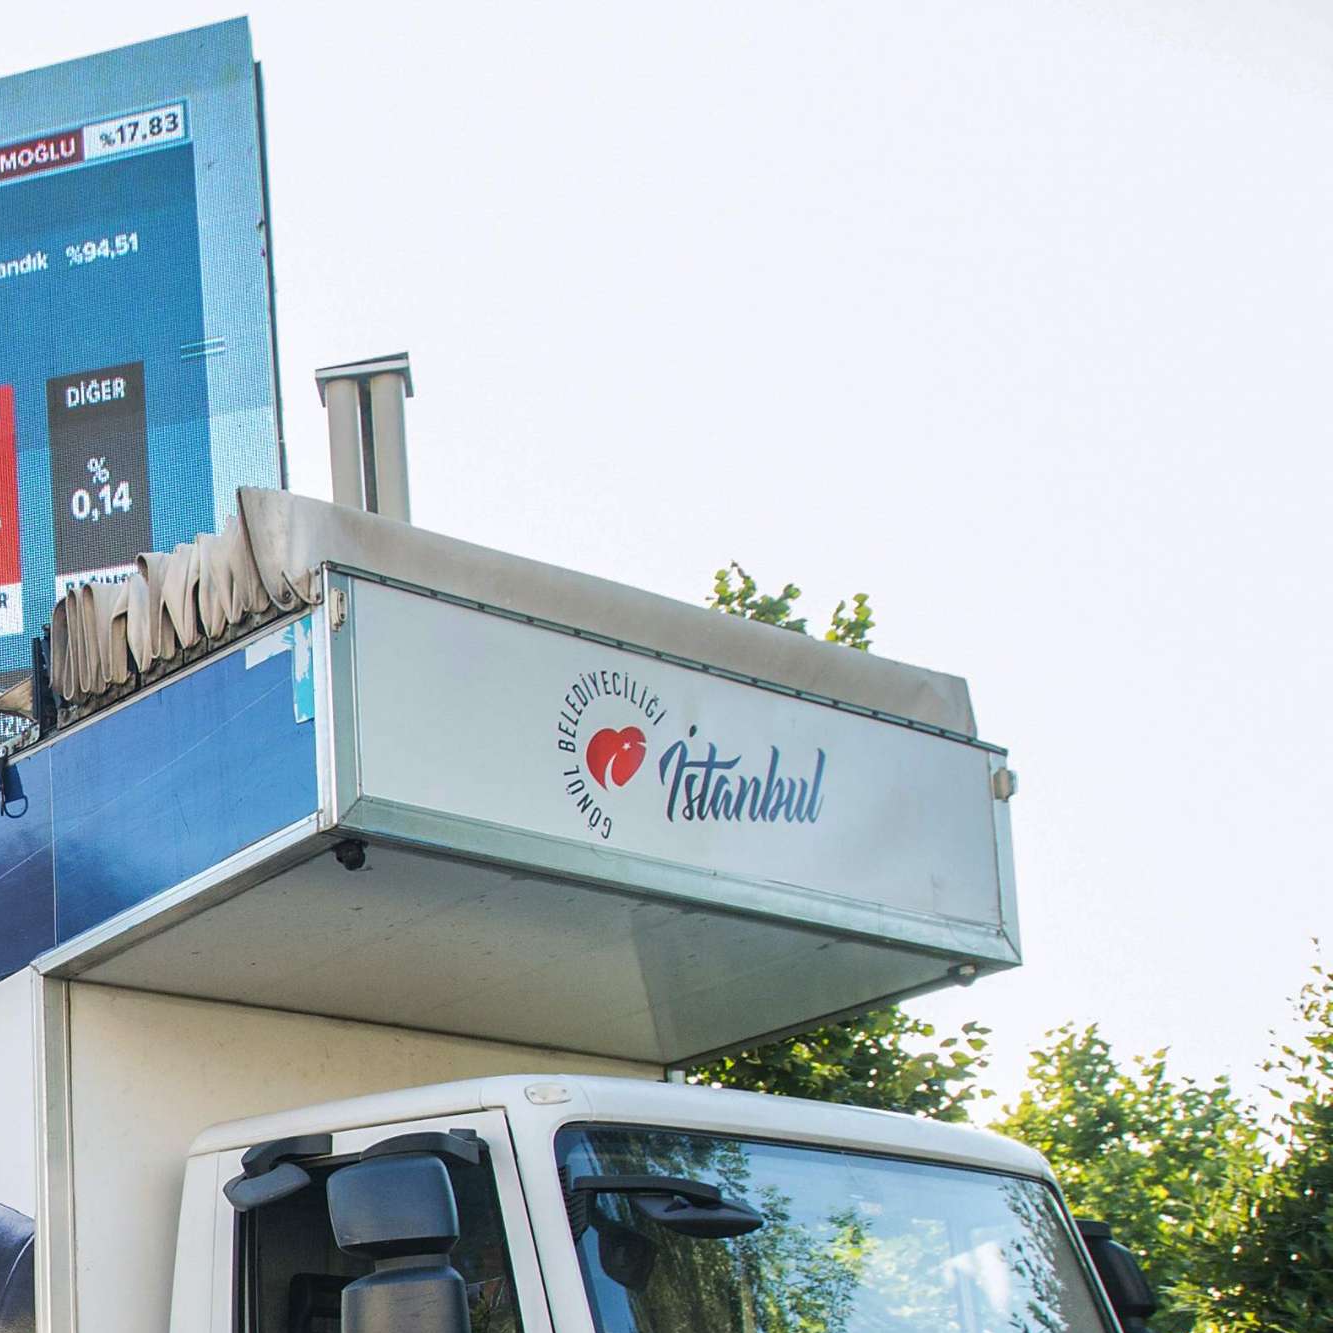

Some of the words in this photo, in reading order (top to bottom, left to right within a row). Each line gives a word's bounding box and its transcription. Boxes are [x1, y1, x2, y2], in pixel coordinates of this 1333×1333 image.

[66, 377, 126, 408] DİĞER
[71, 481, 133, 522] 0,14
[558, 670, 667, 753] BELEDİYECİLİĞİ
[563, 764, 612, 839] GÖNÜL
[659, 724, 826, 823] İstanbul
